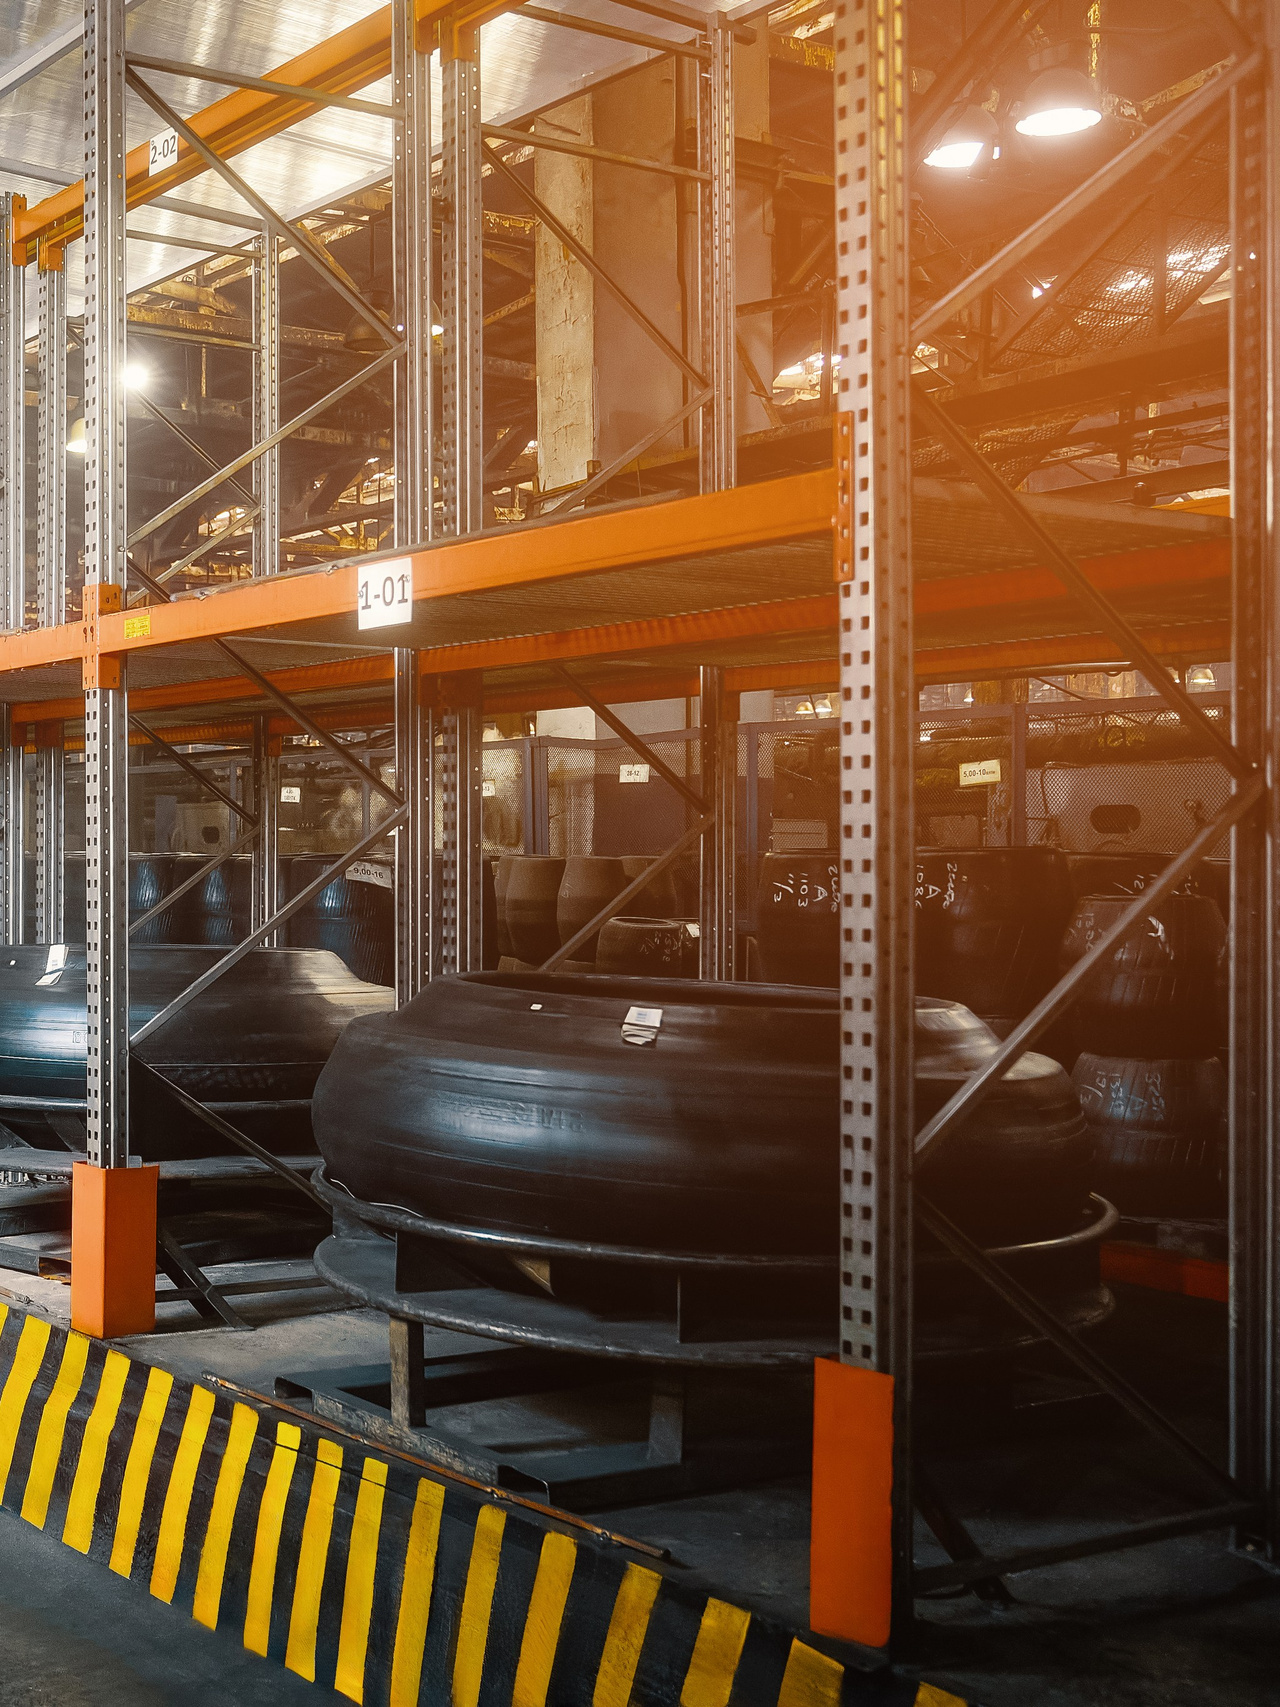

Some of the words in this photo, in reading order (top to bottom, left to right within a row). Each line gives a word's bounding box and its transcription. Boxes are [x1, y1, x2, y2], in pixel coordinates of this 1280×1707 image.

[151, 135, 176, 165] 2-02
[361, 573, 409, 610] 1-01
[813, 885, 828, 902] A
